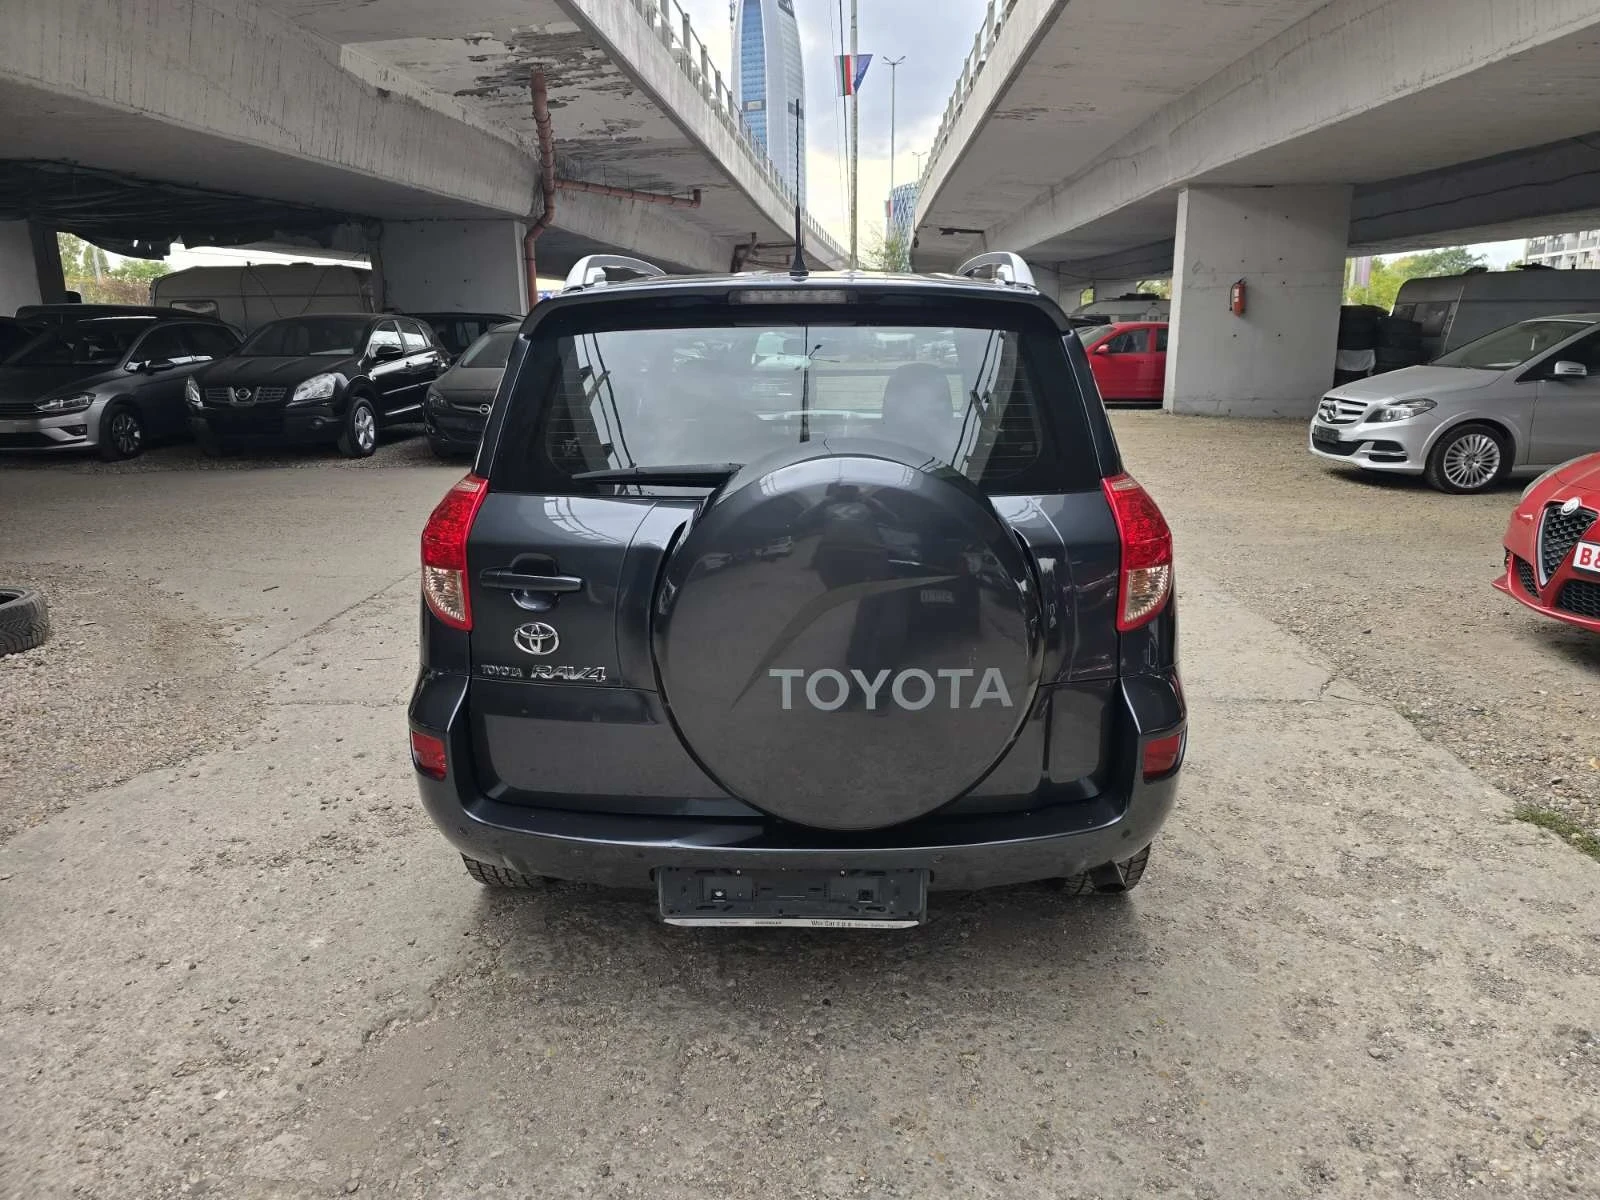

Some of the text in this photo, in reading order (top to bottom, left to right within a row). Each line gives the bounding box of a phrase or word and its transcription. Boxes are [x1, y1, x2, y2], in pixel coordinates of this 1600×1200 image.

[480, 664, 606, 682] TOYOTA RAV4
[768, 667, 1014, 711] TOYOTA
